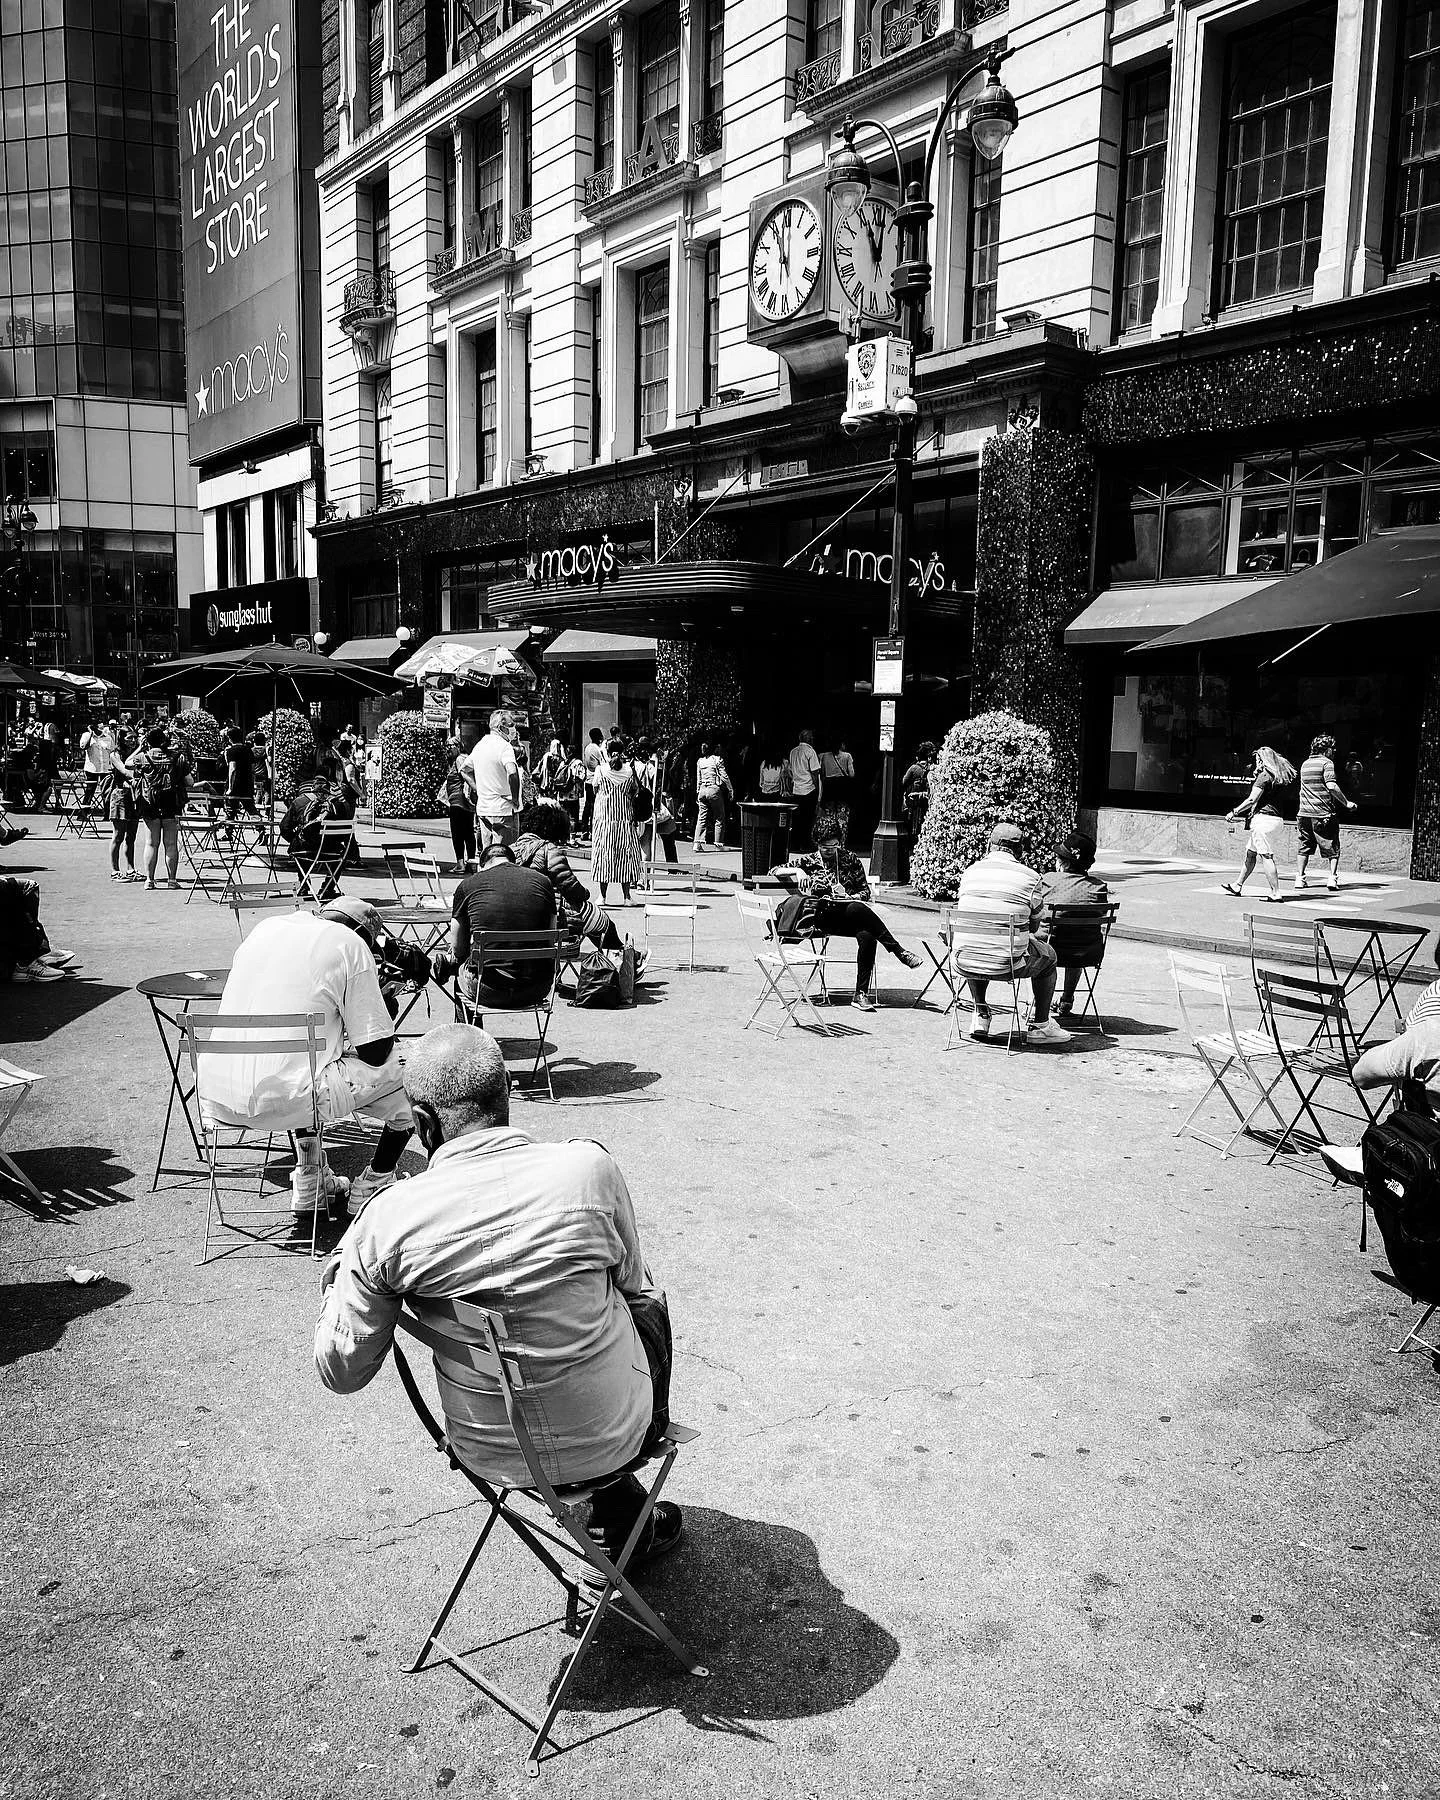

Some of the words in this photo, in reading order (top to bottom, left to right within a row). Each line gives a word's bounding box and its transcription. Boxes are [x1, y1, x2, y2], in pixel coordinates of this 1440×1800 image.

[210, 0, 252, 67] THE
[188, 23, 281, 155] WORLD'S
[191, 97, 280, 220] LARGEST
[205, 180, 270, 274] STORE
[211, 323, 289, 414] macy's
[541, 534, 614, 583] macy's
[846, 549, 945, 598] may's
[220, 603, 256, 633] sunglass
[256, 600, 273, 625] hut
